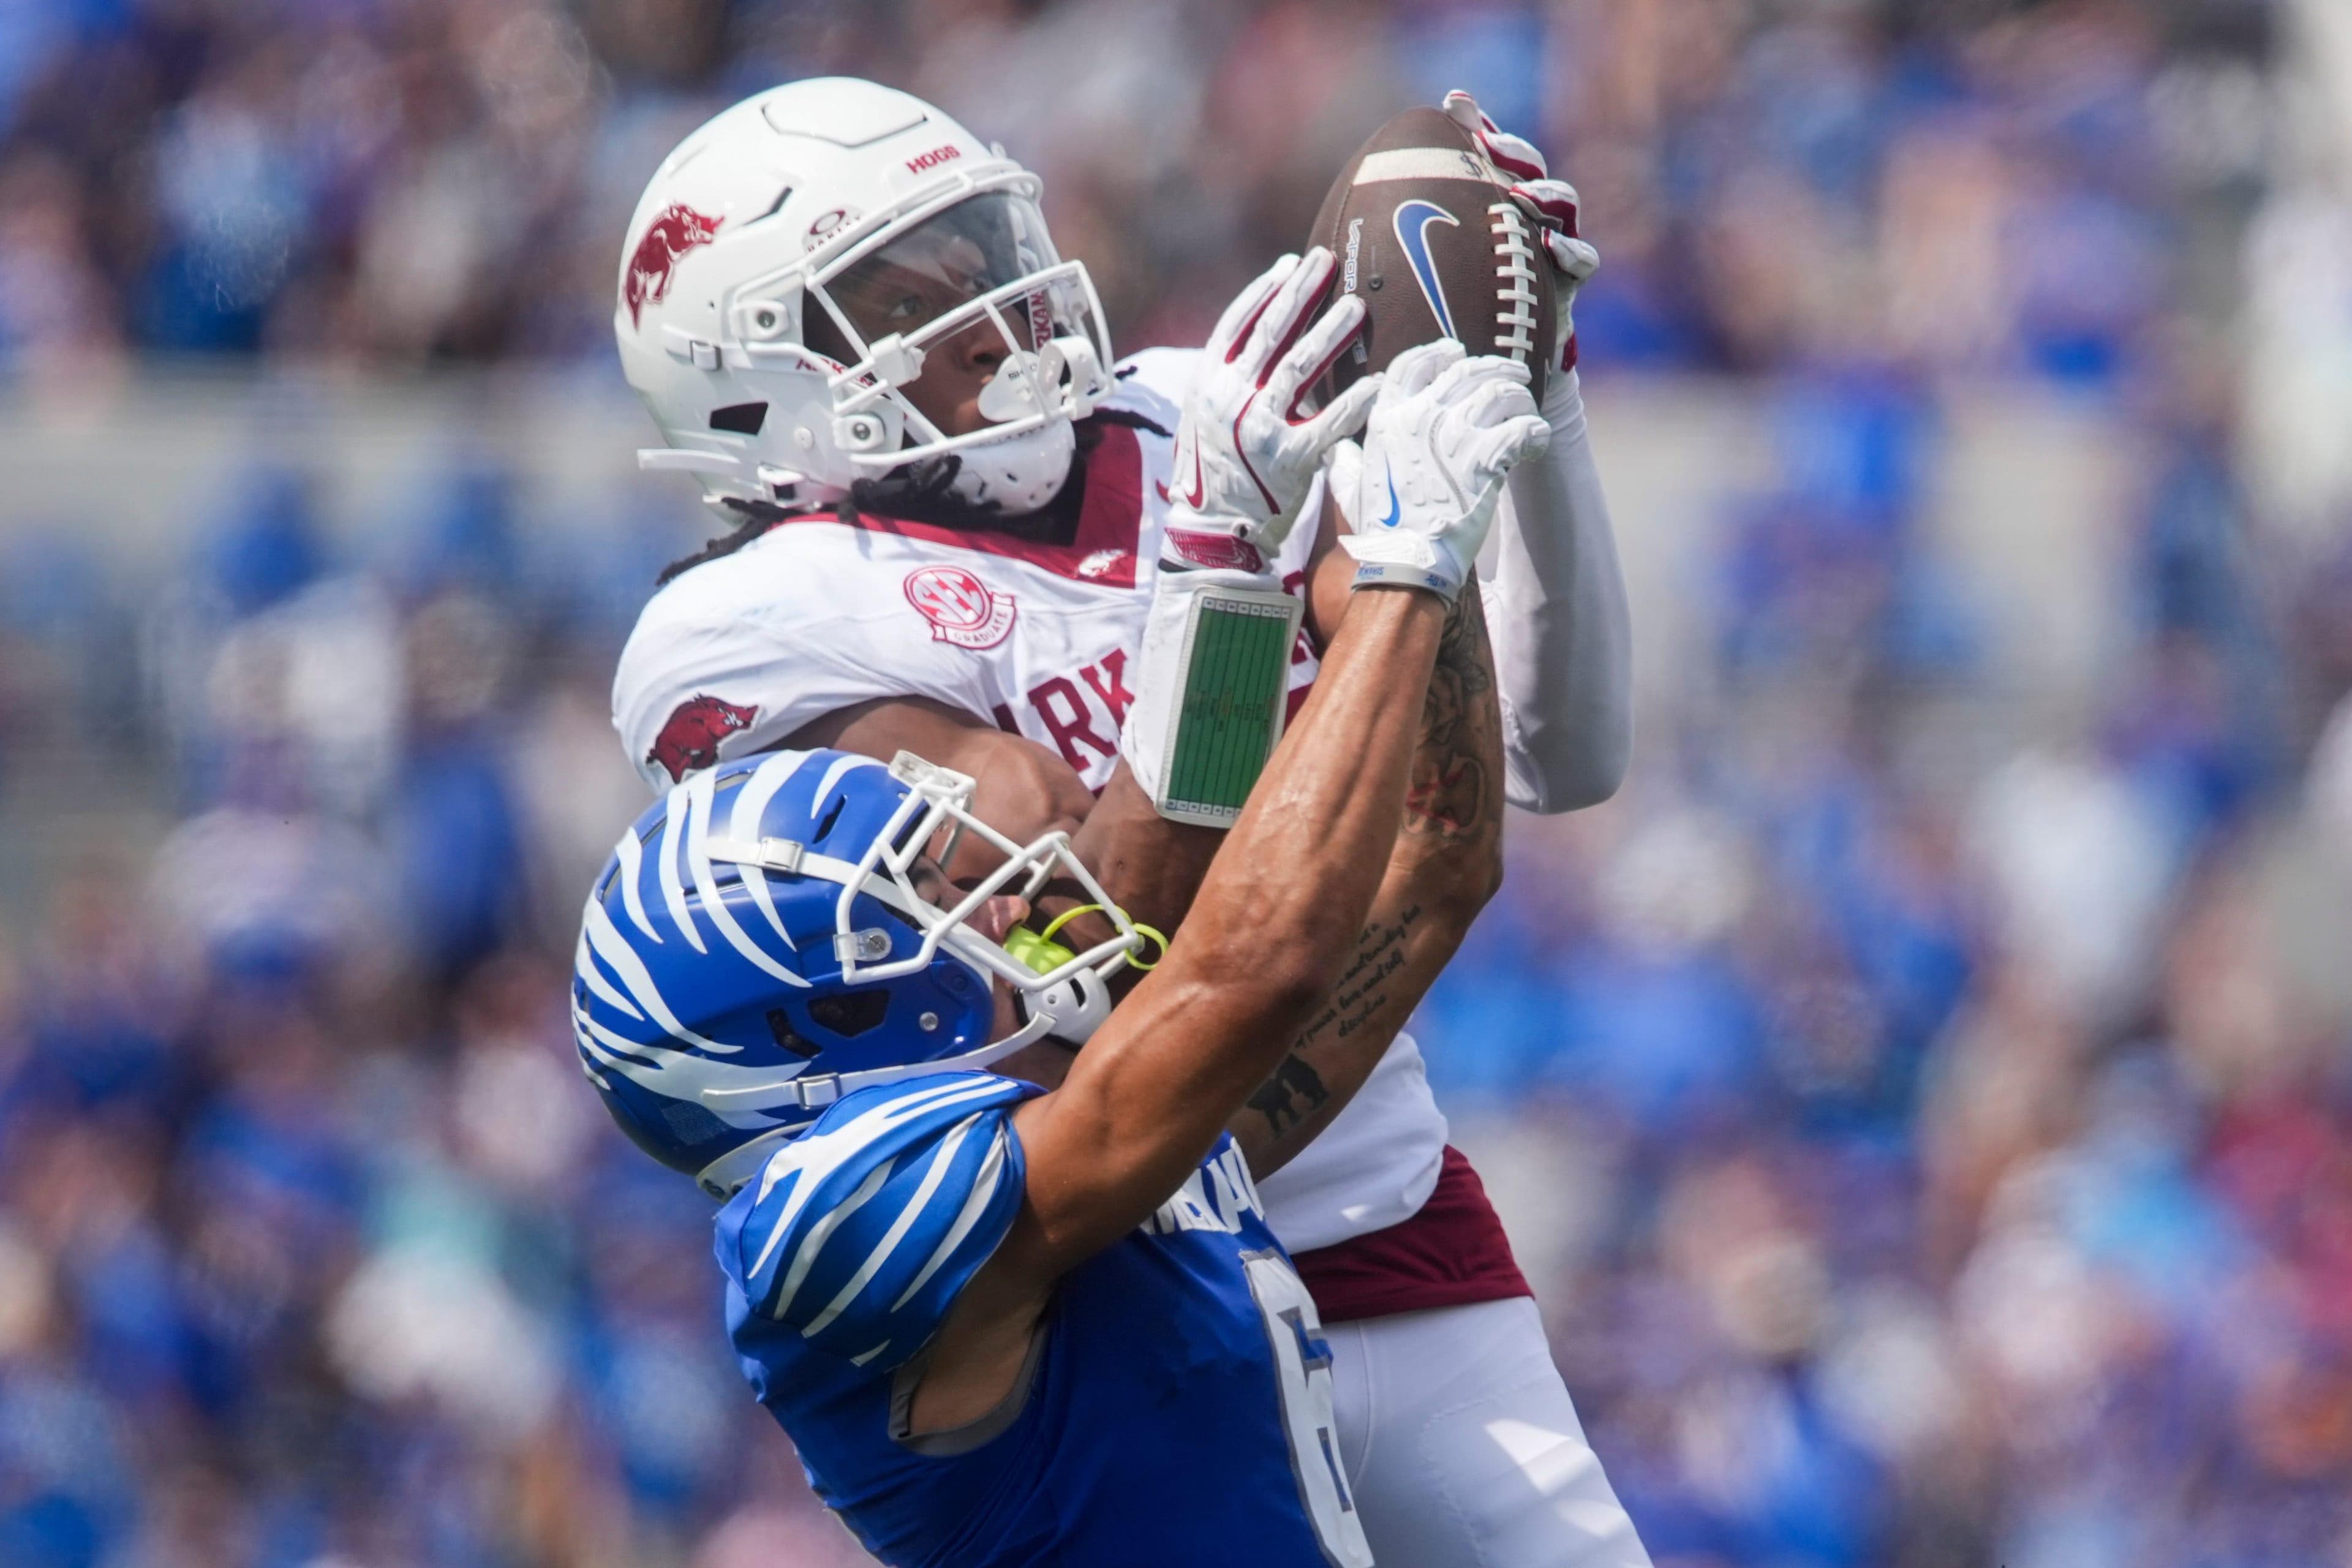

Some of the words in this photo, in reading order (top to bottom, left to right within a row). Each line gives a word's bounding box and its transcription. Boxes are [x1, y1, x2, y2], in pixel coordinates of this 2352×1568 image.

[906, 145, 961, 174] HOGS
[1344, 218, 1363, 293] VAPOR
[913, 572, 983, 625] SEC
[954, 608, 1008, 643] GRADUATE
